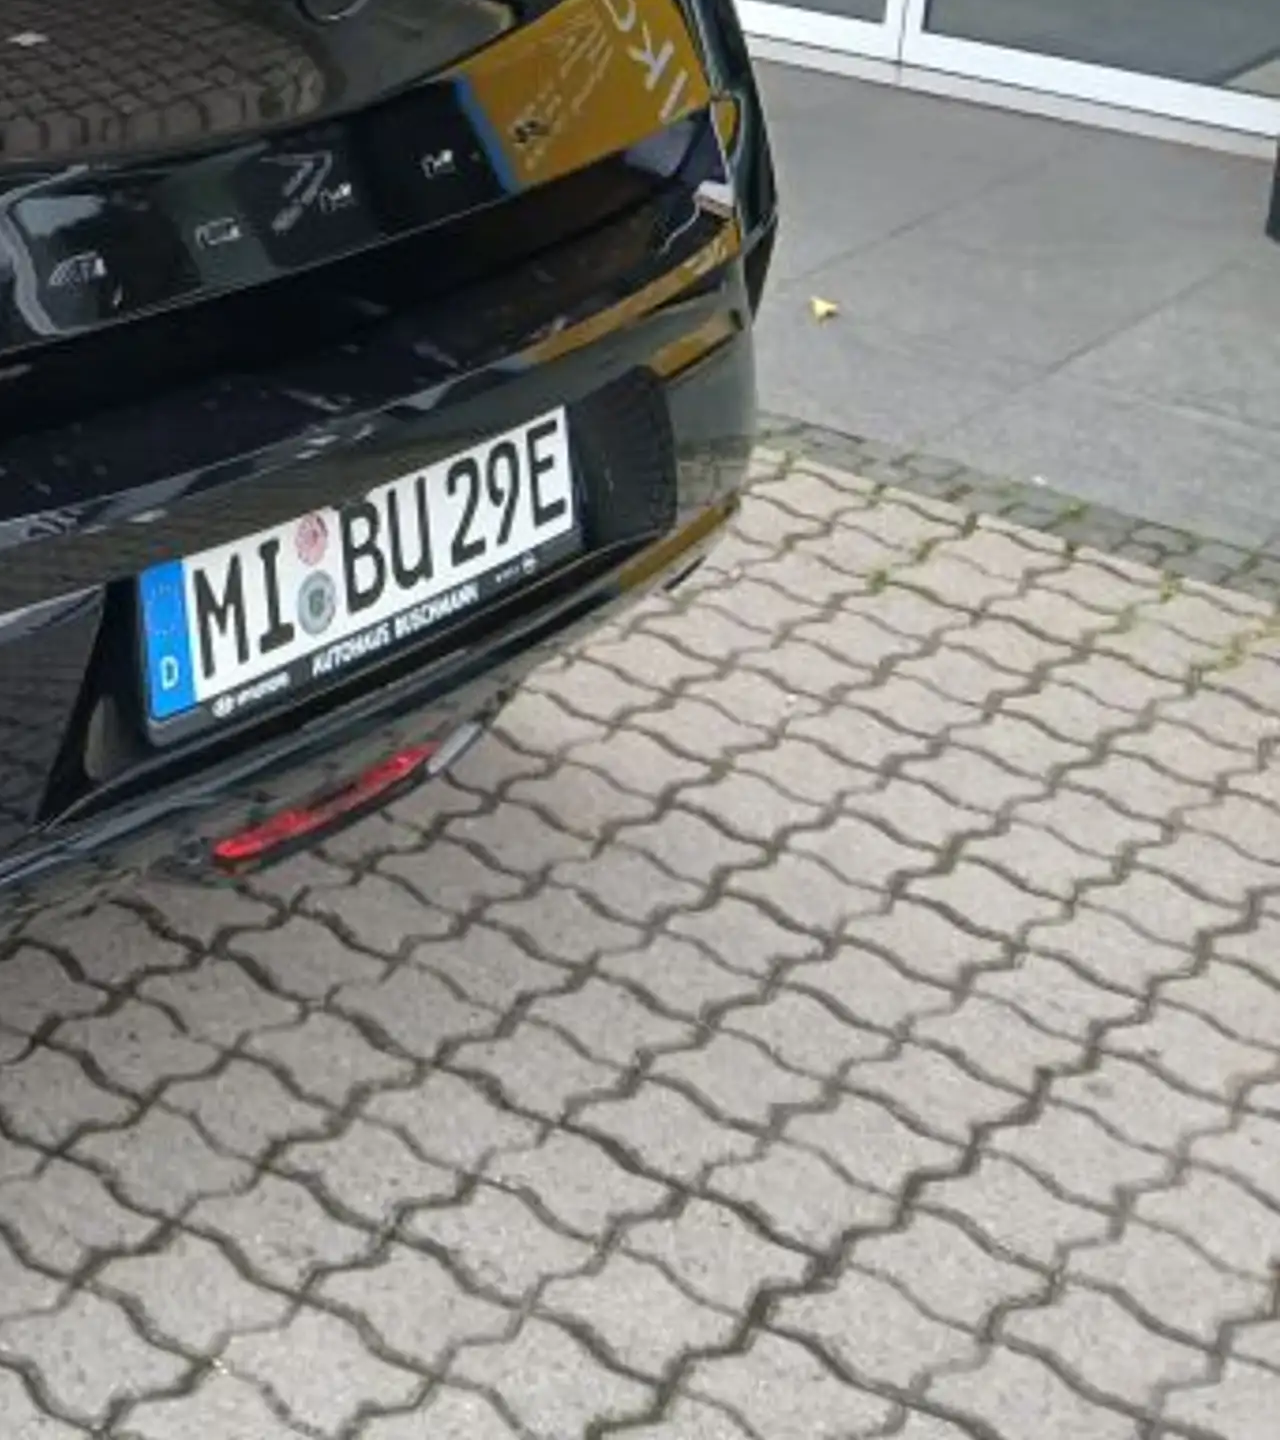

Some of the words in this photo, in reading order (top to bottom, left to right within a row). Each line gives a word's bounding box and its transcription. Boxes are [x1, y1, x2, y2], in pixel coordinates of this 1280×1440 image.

[192, 537, 296, 681] MI
[341, 476, 435, 616] BU
[446, 418, 568, 568] 29E
[160, 655, 179, 690] D
[311, 626, 390, 677] AUTOHAUS
[394, 582, 480, 641] BUSCHMANN
